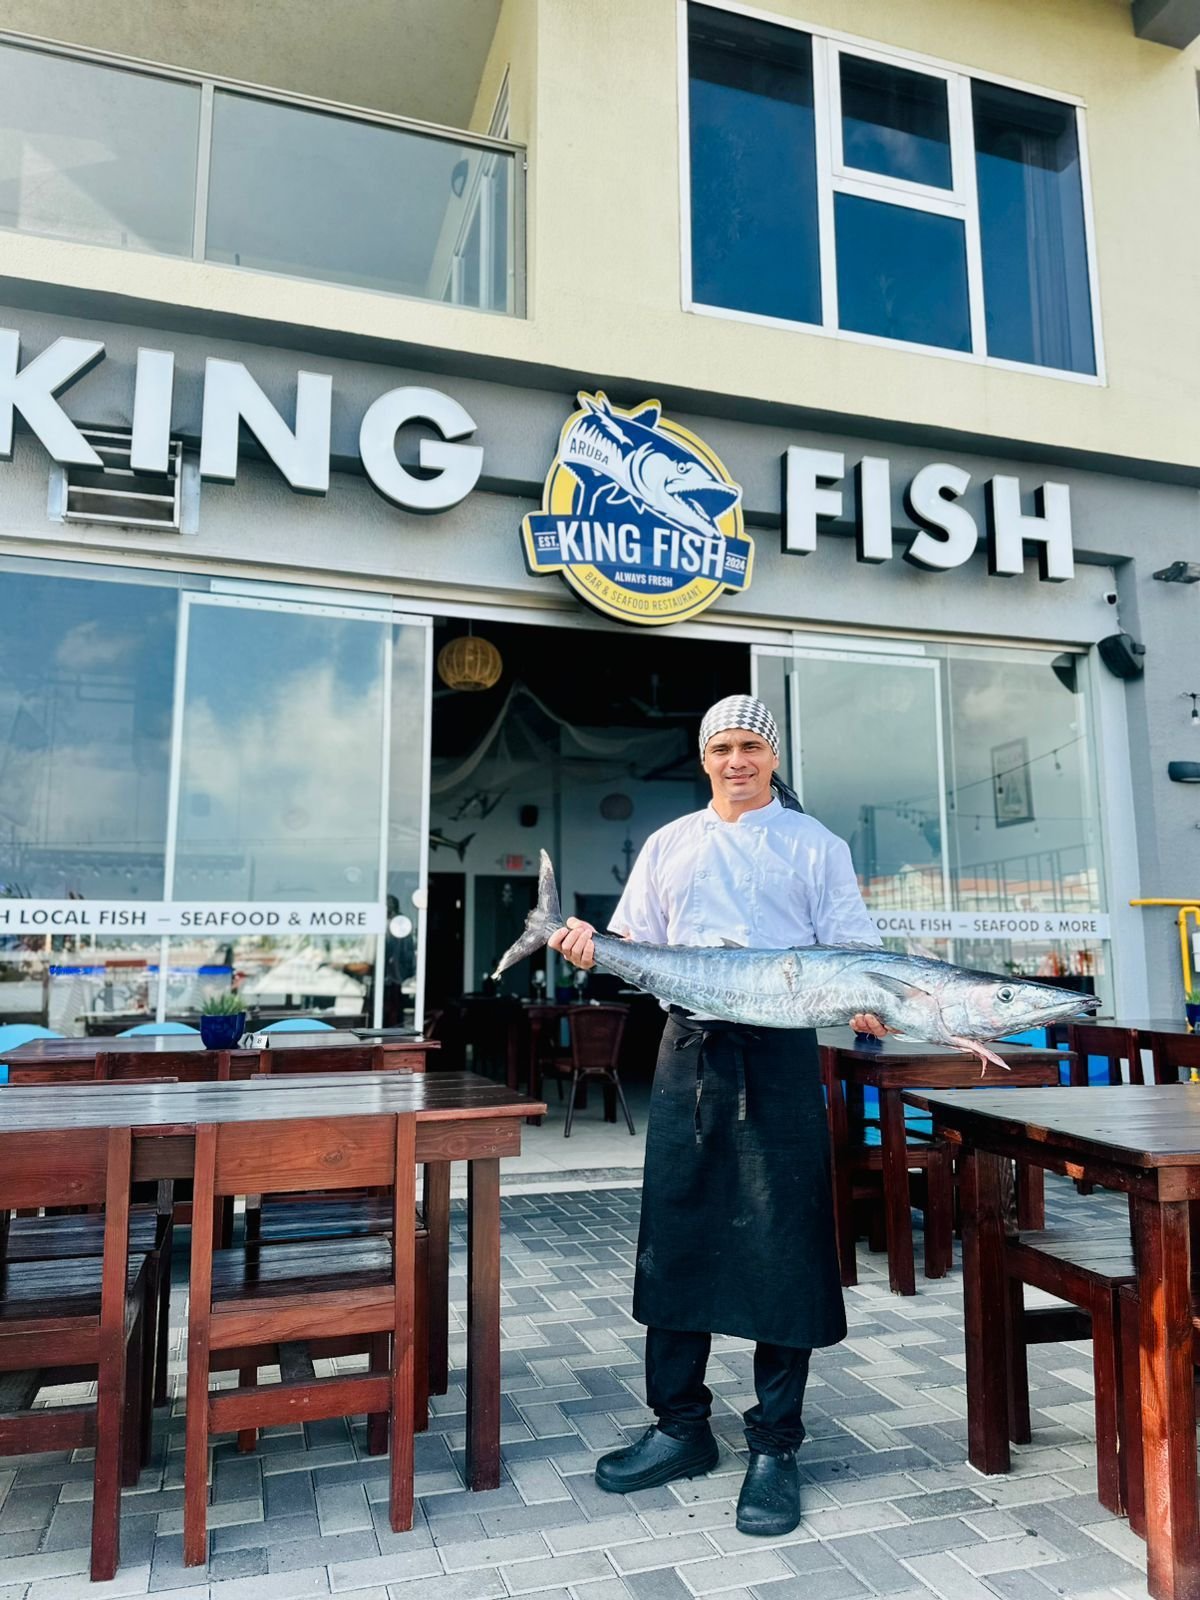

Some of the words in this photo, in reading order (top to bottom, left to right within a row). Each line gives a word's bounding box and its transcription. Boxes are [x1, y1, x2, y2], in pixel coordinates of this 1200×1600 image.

[0, 329, 484, 511] KING
[783, 445, 1075, 581] FISH
[569, 437, 609, 465] ARUBA
[538, 535, 559, 548] EST.
[556, 520, 642, 565] KING
[653, 527, 727, 579] FISH
[725, 555, 746, 571] 2024
[614, 571, 647, 585] ALWAYS
[647, 574, 674, 588] FRESH
[584, 571, 602, 590] BAR
[601, 586, 609, 595] &
[610, 589, 650, 611] SEAFOOD
[652, 584, 704, 611] RESTAURANT
[20, 909, 91, 925] LOCAL
[99, 910, 147, 925] FISH
[180, 911, 280, 926] SEAFOOD
[287, 912, 300, 926] &
[309, 912, 367, 926] MORE
[870, 917, 915, 931] OCAL
[920, 918, 952, 931] FISH
[973, 919, 1040, 932] SEAFOOD
[1044, 920, 1054, 932] &
[1059, 920, 1097, 932] MORE
